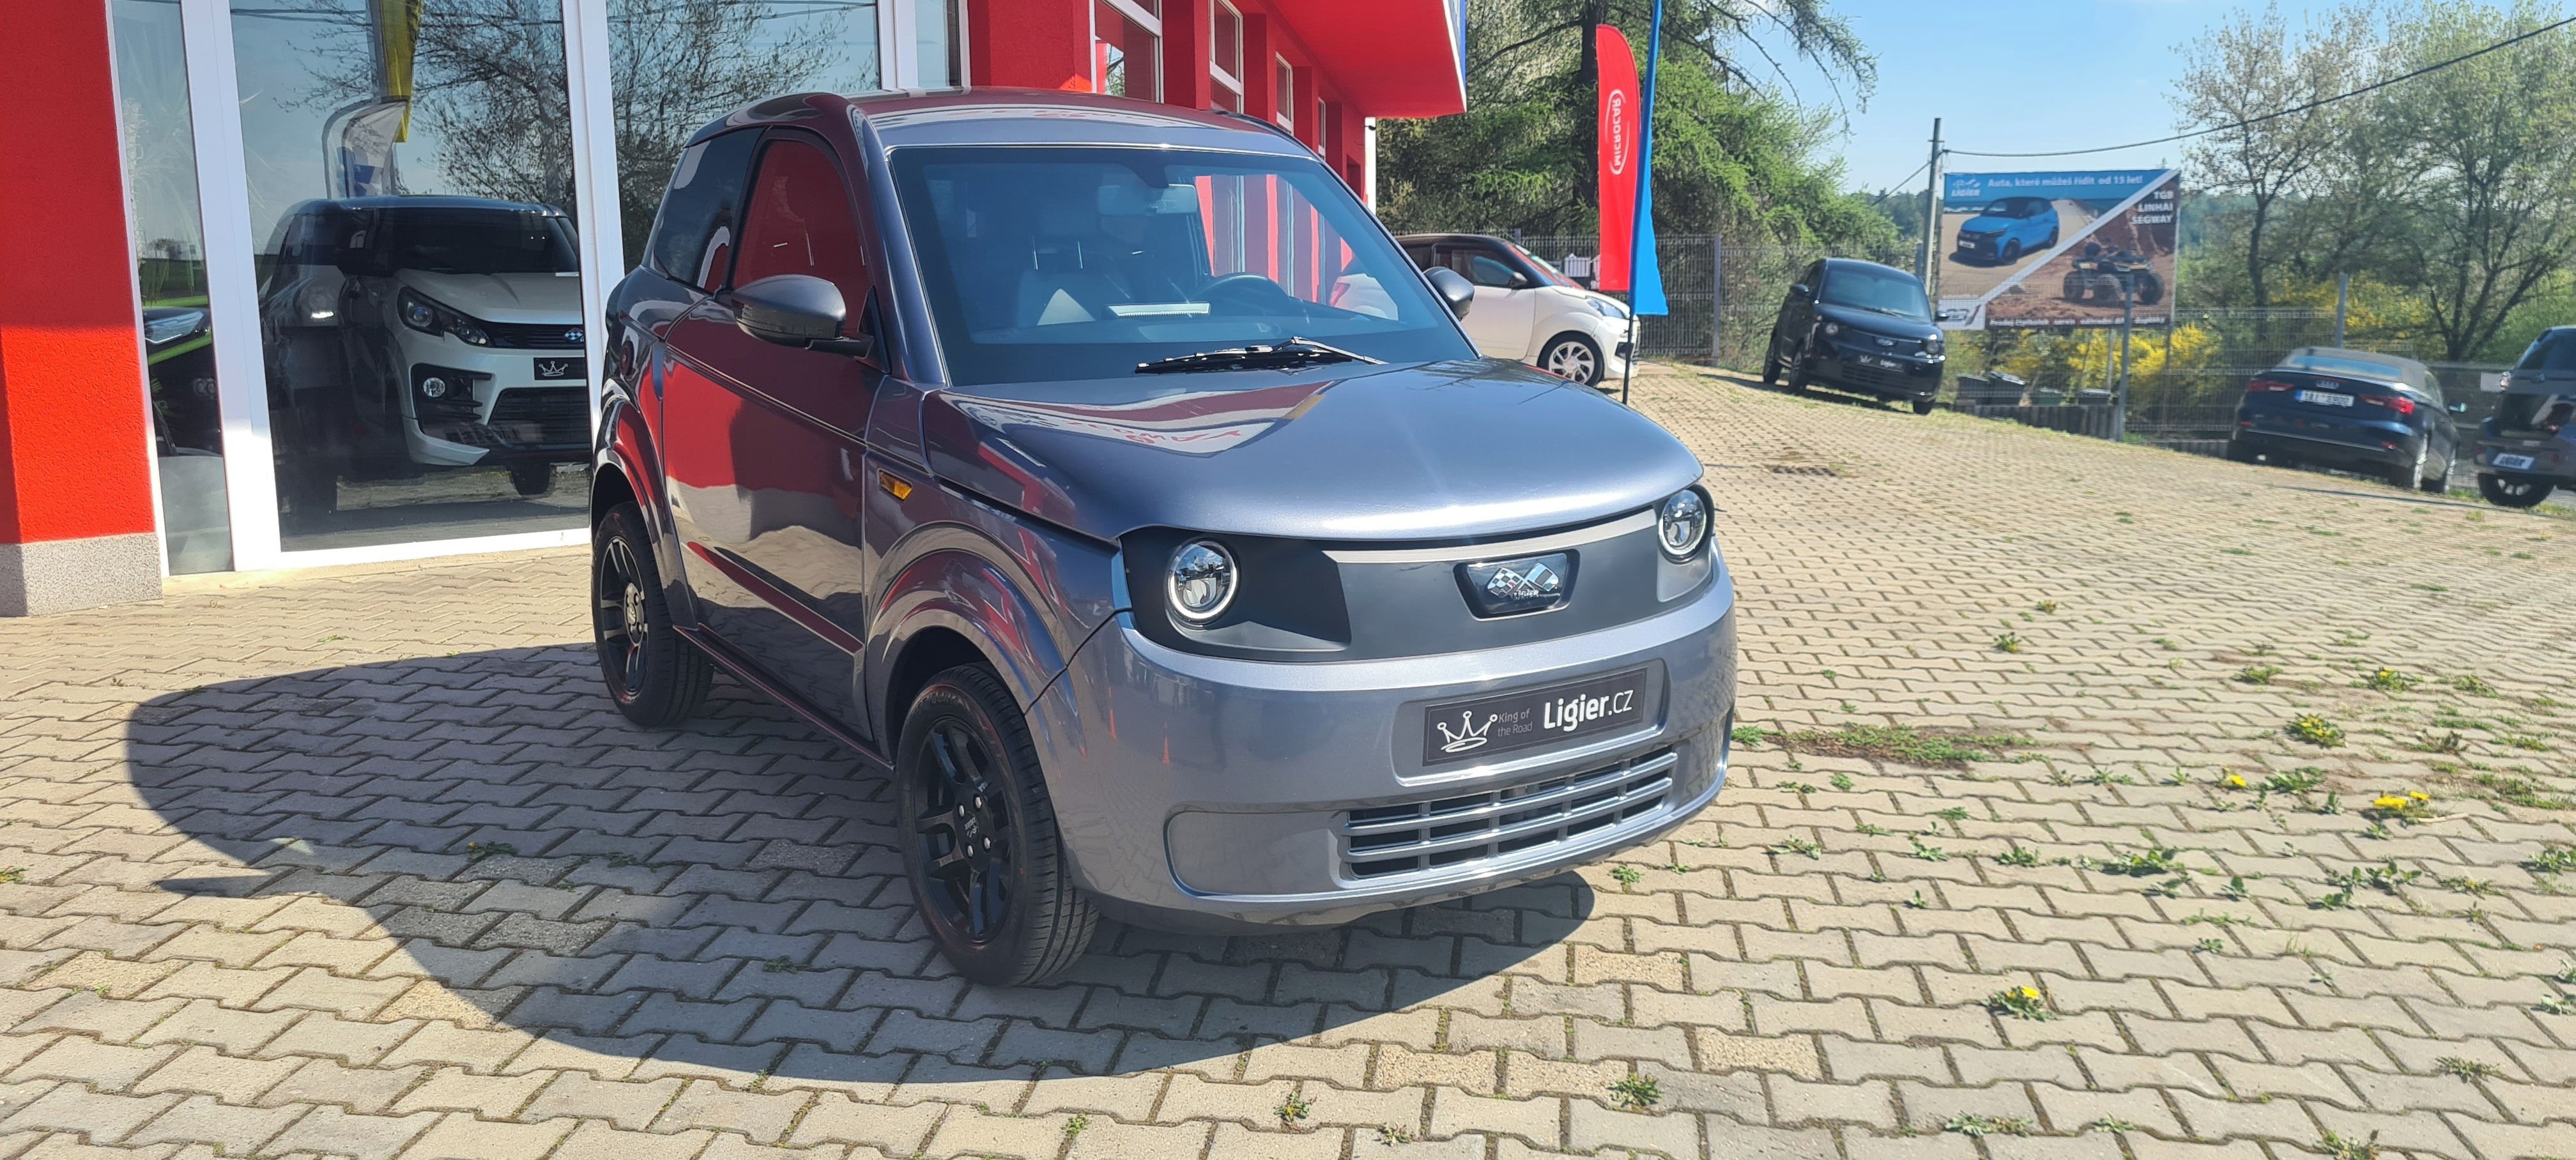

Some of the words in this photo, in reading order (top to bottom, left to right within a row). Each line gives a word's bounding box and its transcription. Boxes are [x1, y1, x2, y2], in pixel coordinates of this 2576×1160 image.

[2099, 176, 2112, 185] od
[2138, 204, 2174, 212] LINHAI
[2131, 215, 2172, 224] SEGWAY
[1498, 712, 1519, 723] King
[1521, 708, 1531, 719] of
[1498, 726, 1512, 736] the
[1512, 722, 1533, 734] Road
